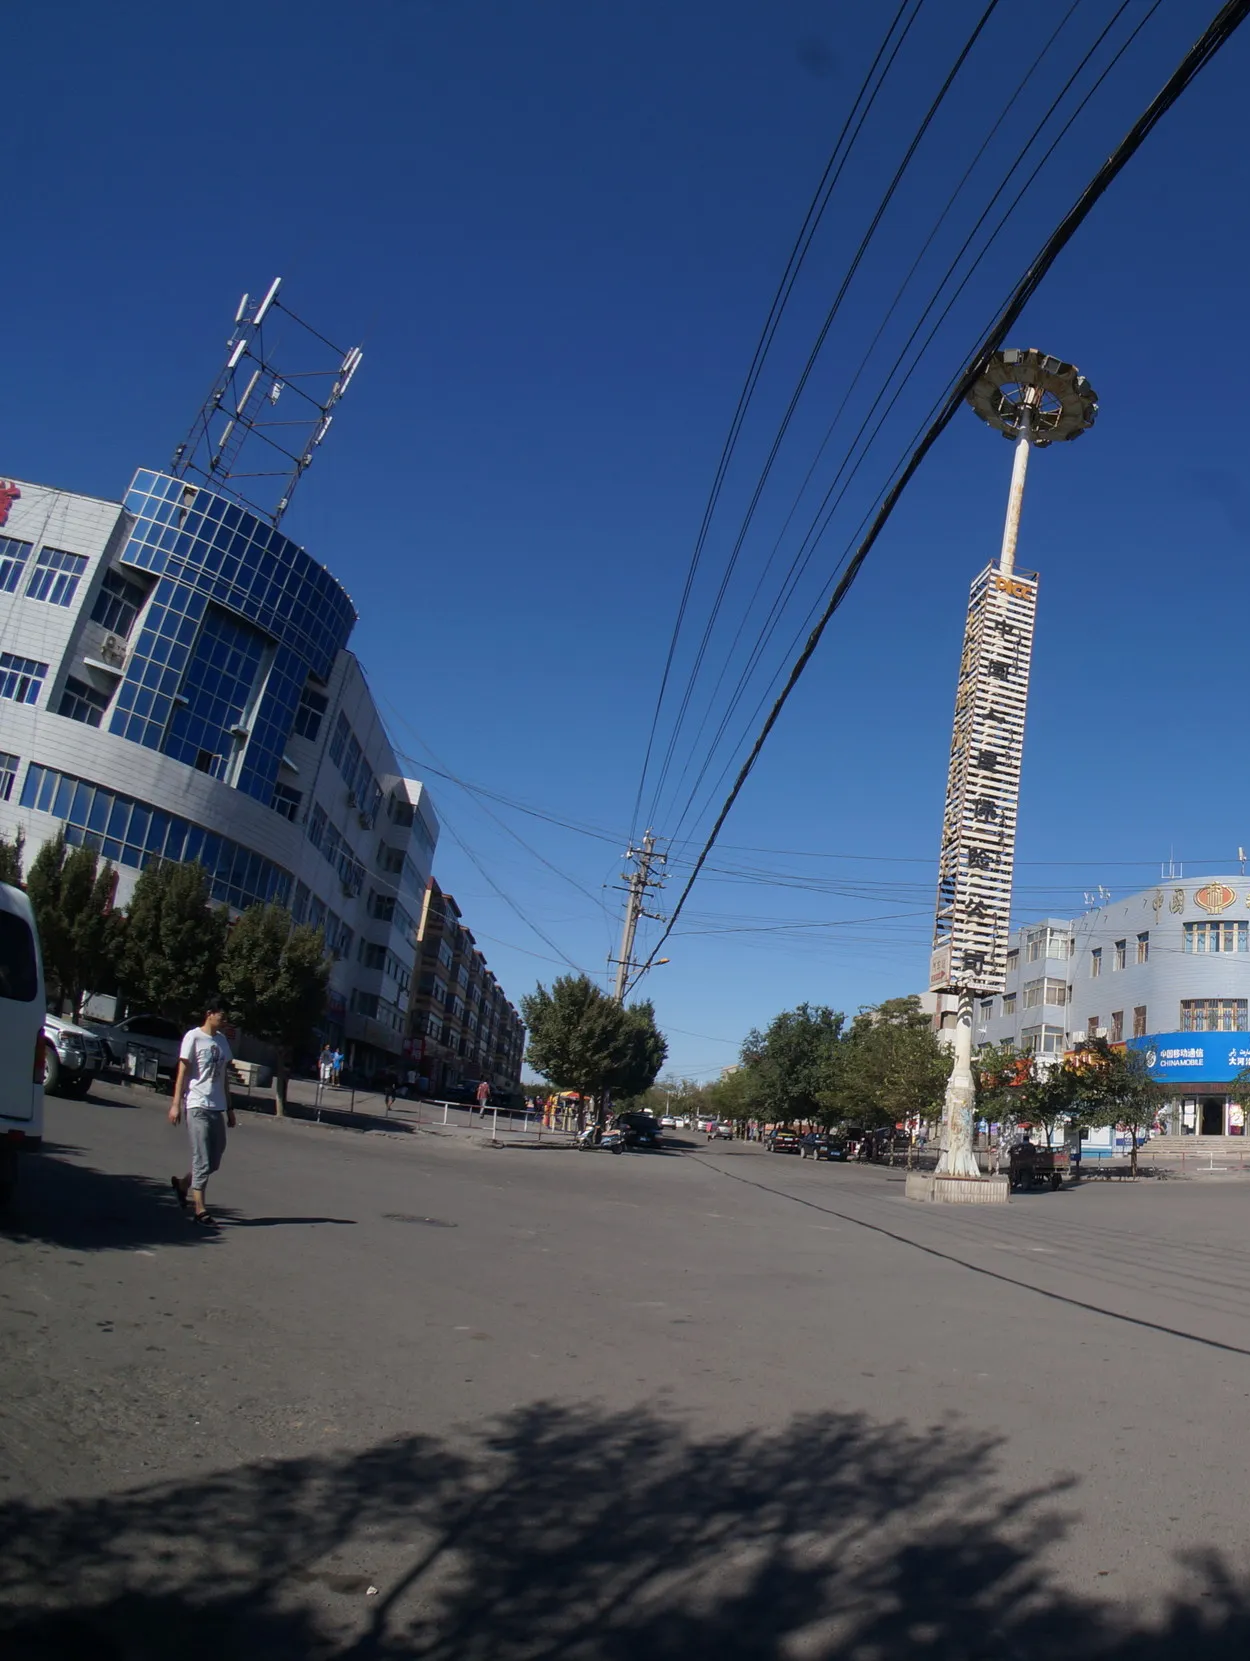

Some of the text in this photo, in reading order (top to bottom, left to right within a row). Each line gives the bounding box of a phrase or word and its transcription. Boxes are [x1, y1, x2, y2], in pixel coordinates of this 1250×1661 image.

[996, 576, 1032, 601] PICC
[1152, 888, 1186, 925] 中国
[1160, 1048, 1204, 1059] 中国移动通信
